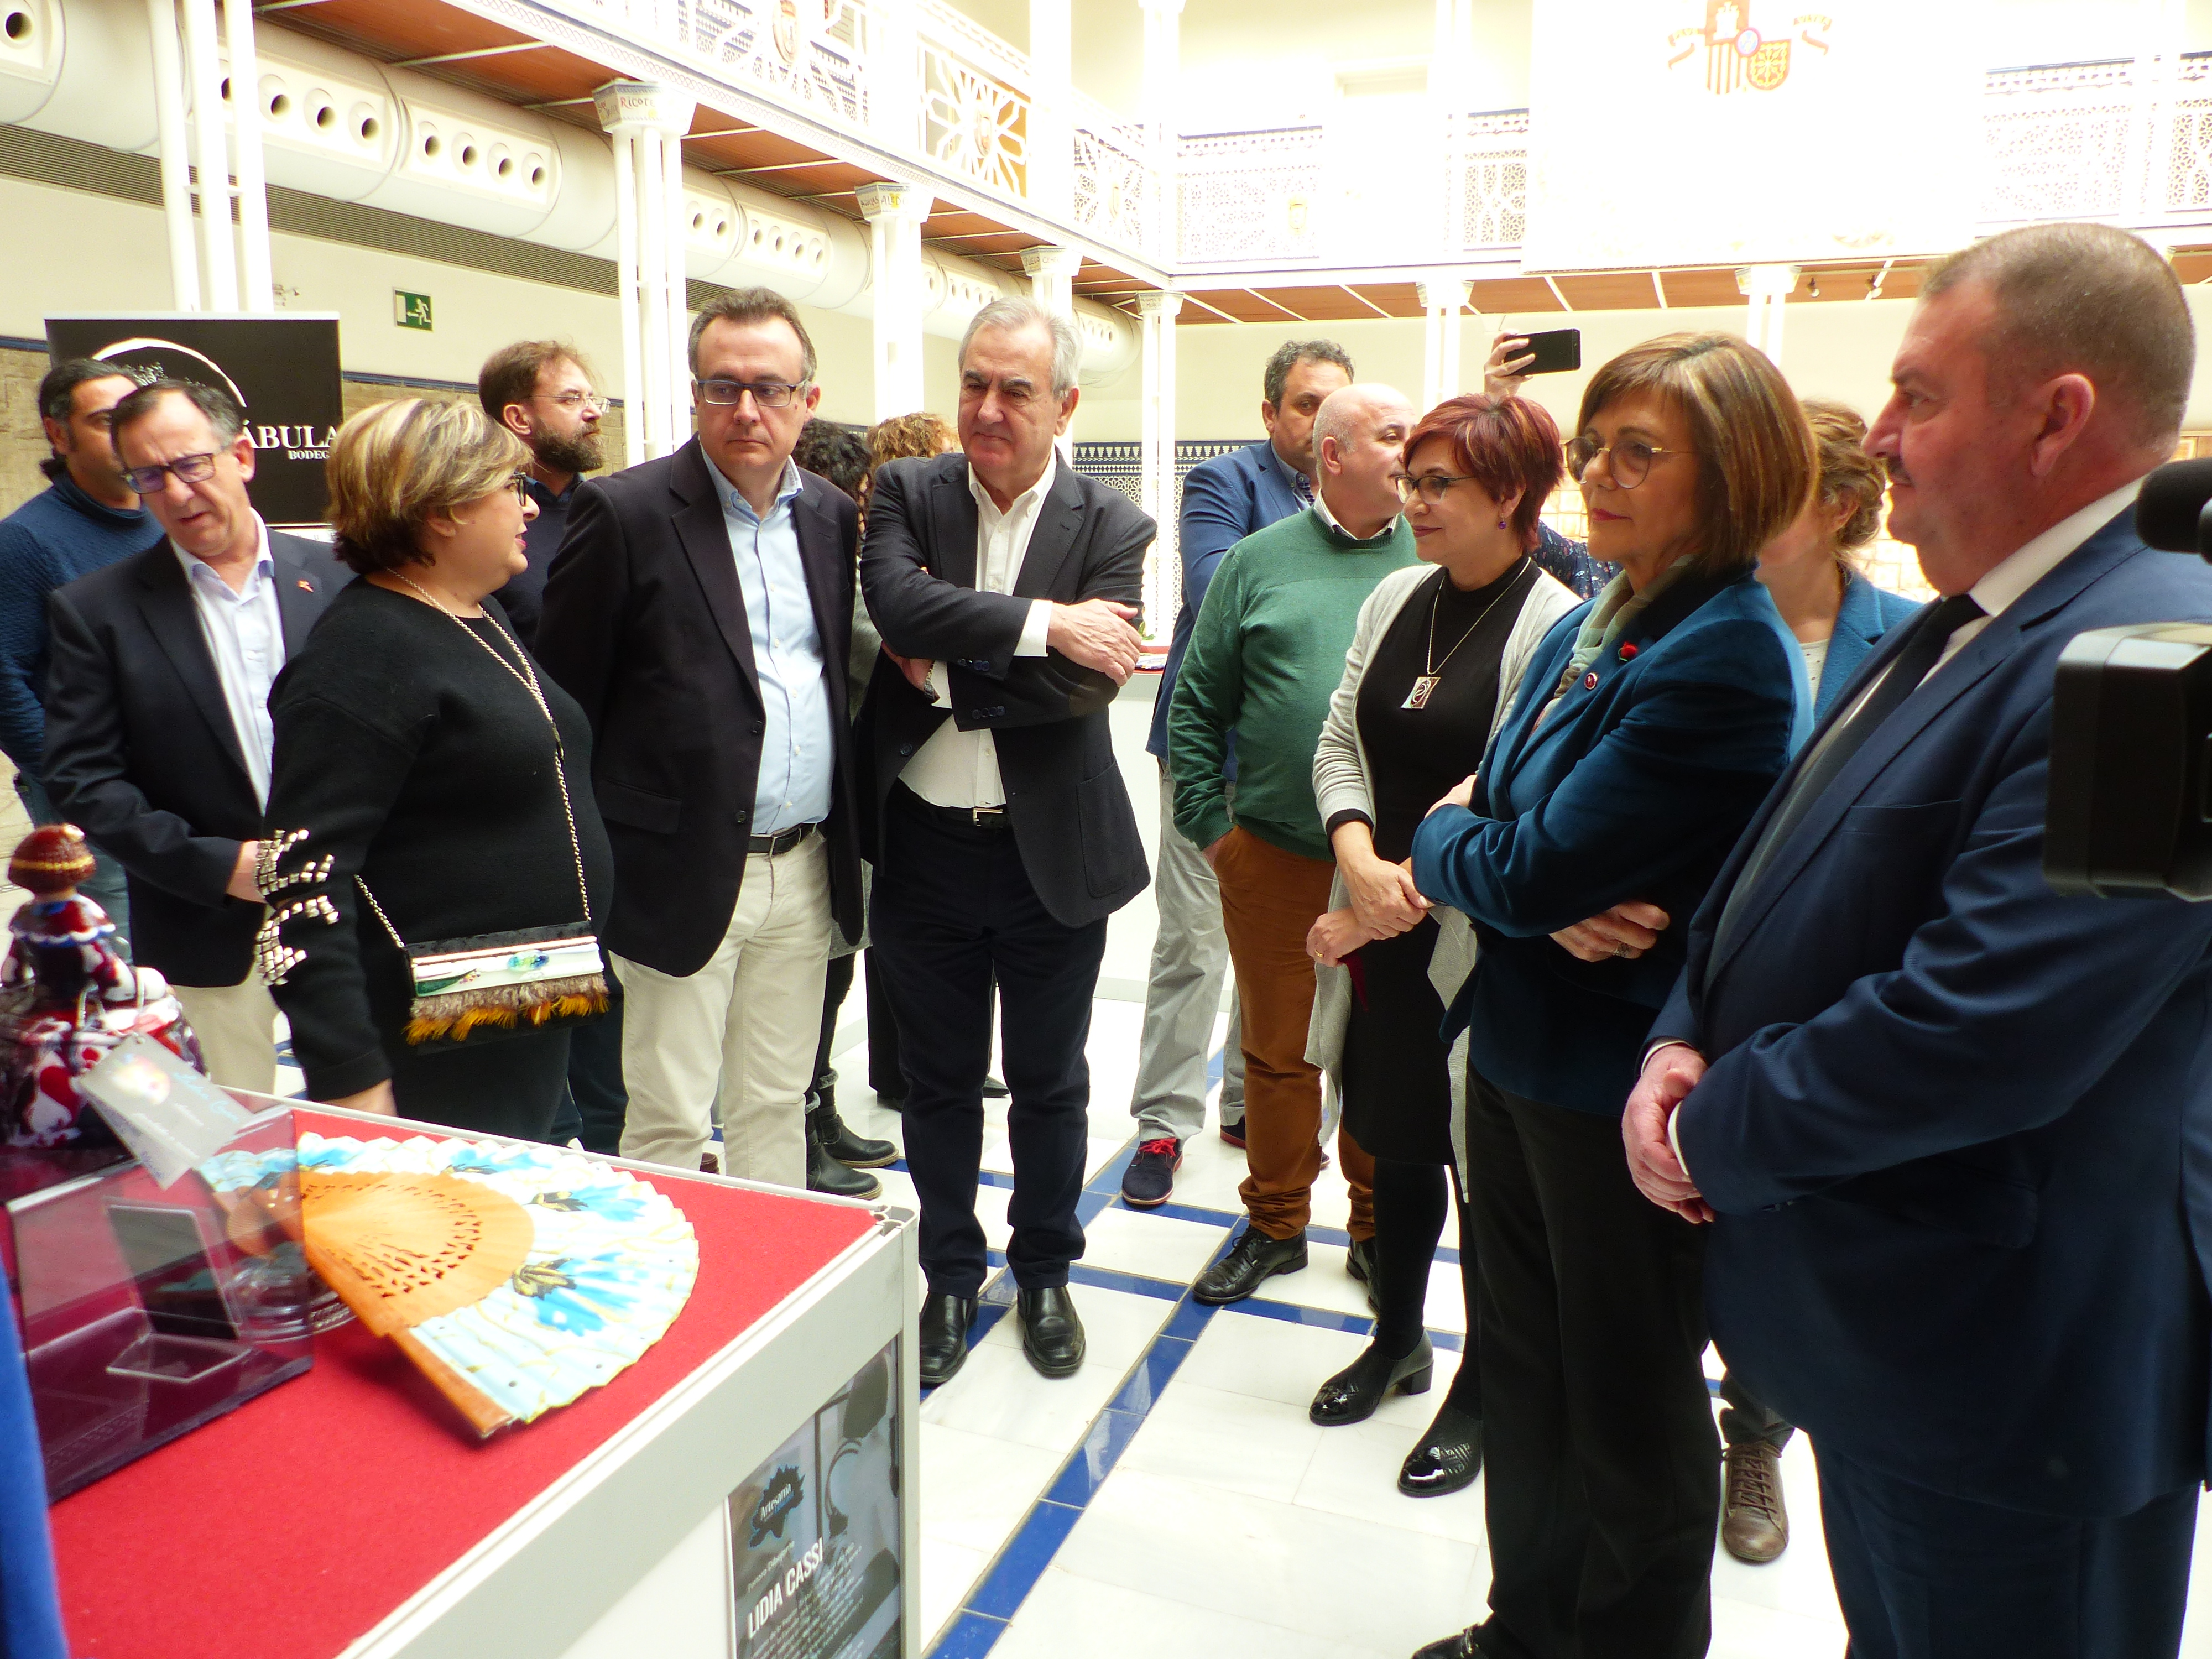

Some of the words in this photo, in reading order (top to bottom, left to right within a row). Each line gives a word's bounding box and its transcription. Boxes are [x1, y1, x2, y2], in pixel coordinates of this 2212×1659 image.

[620, 96, 655, 109] RICOTE
[748, 1582, 783, 1639] LIDIA
[785, 1537, 823, 1597] CASSI
